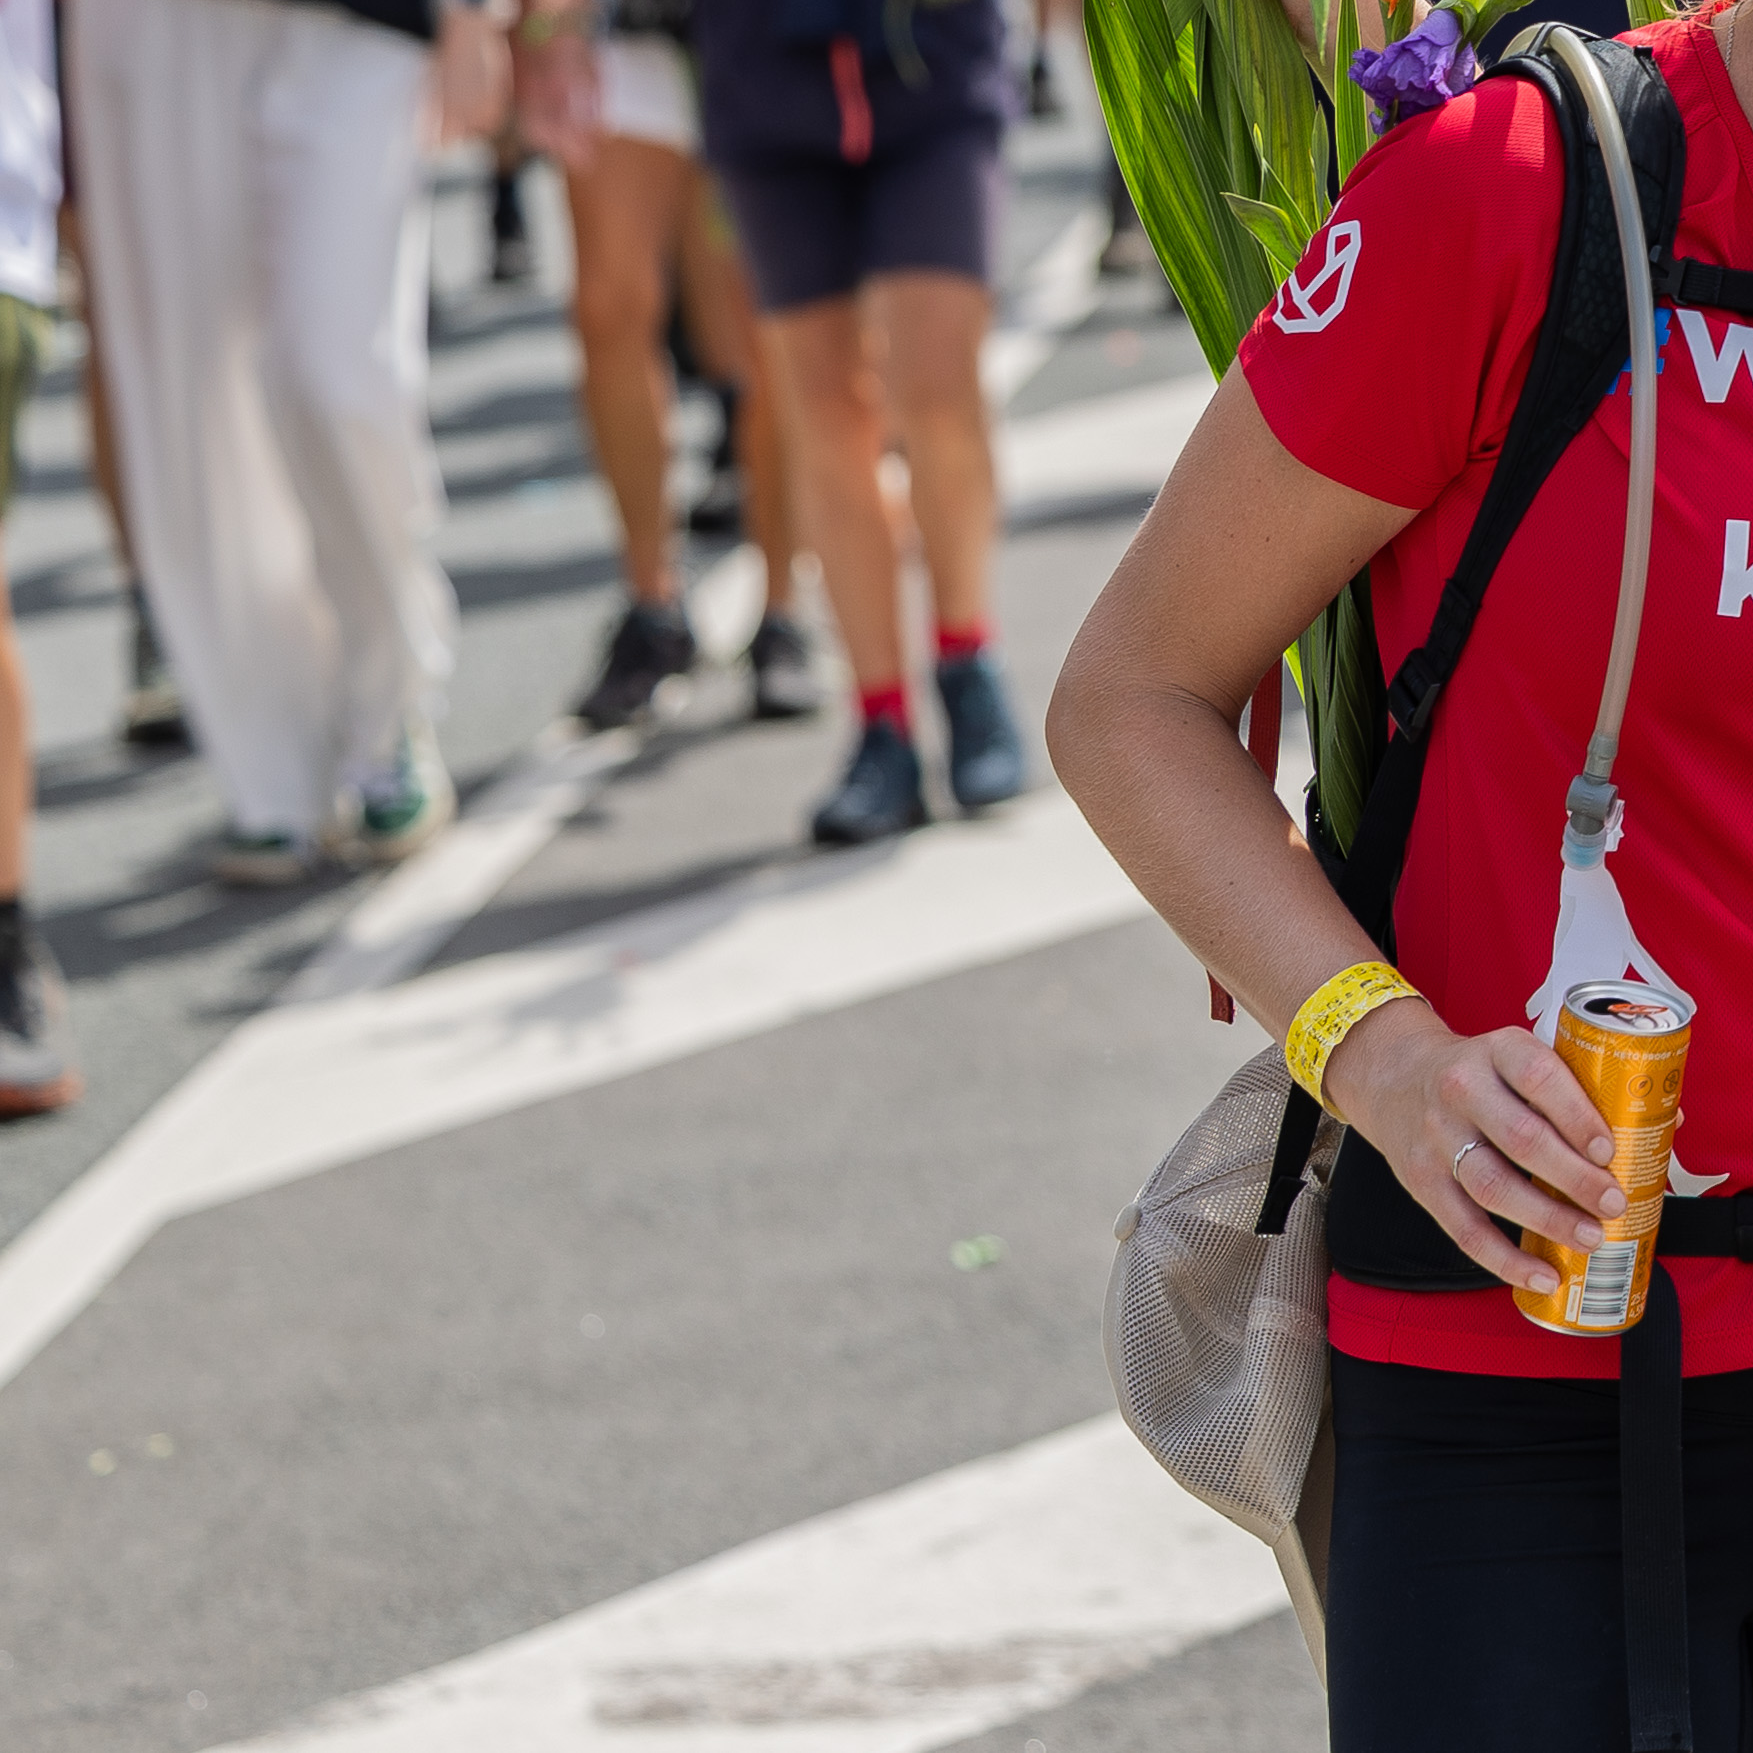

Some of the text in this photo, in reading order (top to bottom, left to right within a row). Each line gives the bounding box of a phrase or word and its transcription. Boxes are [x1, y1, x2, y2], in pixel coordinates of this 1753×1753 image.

[1574, 1037, 1672, 1062] VEGAN KETO PROOF
